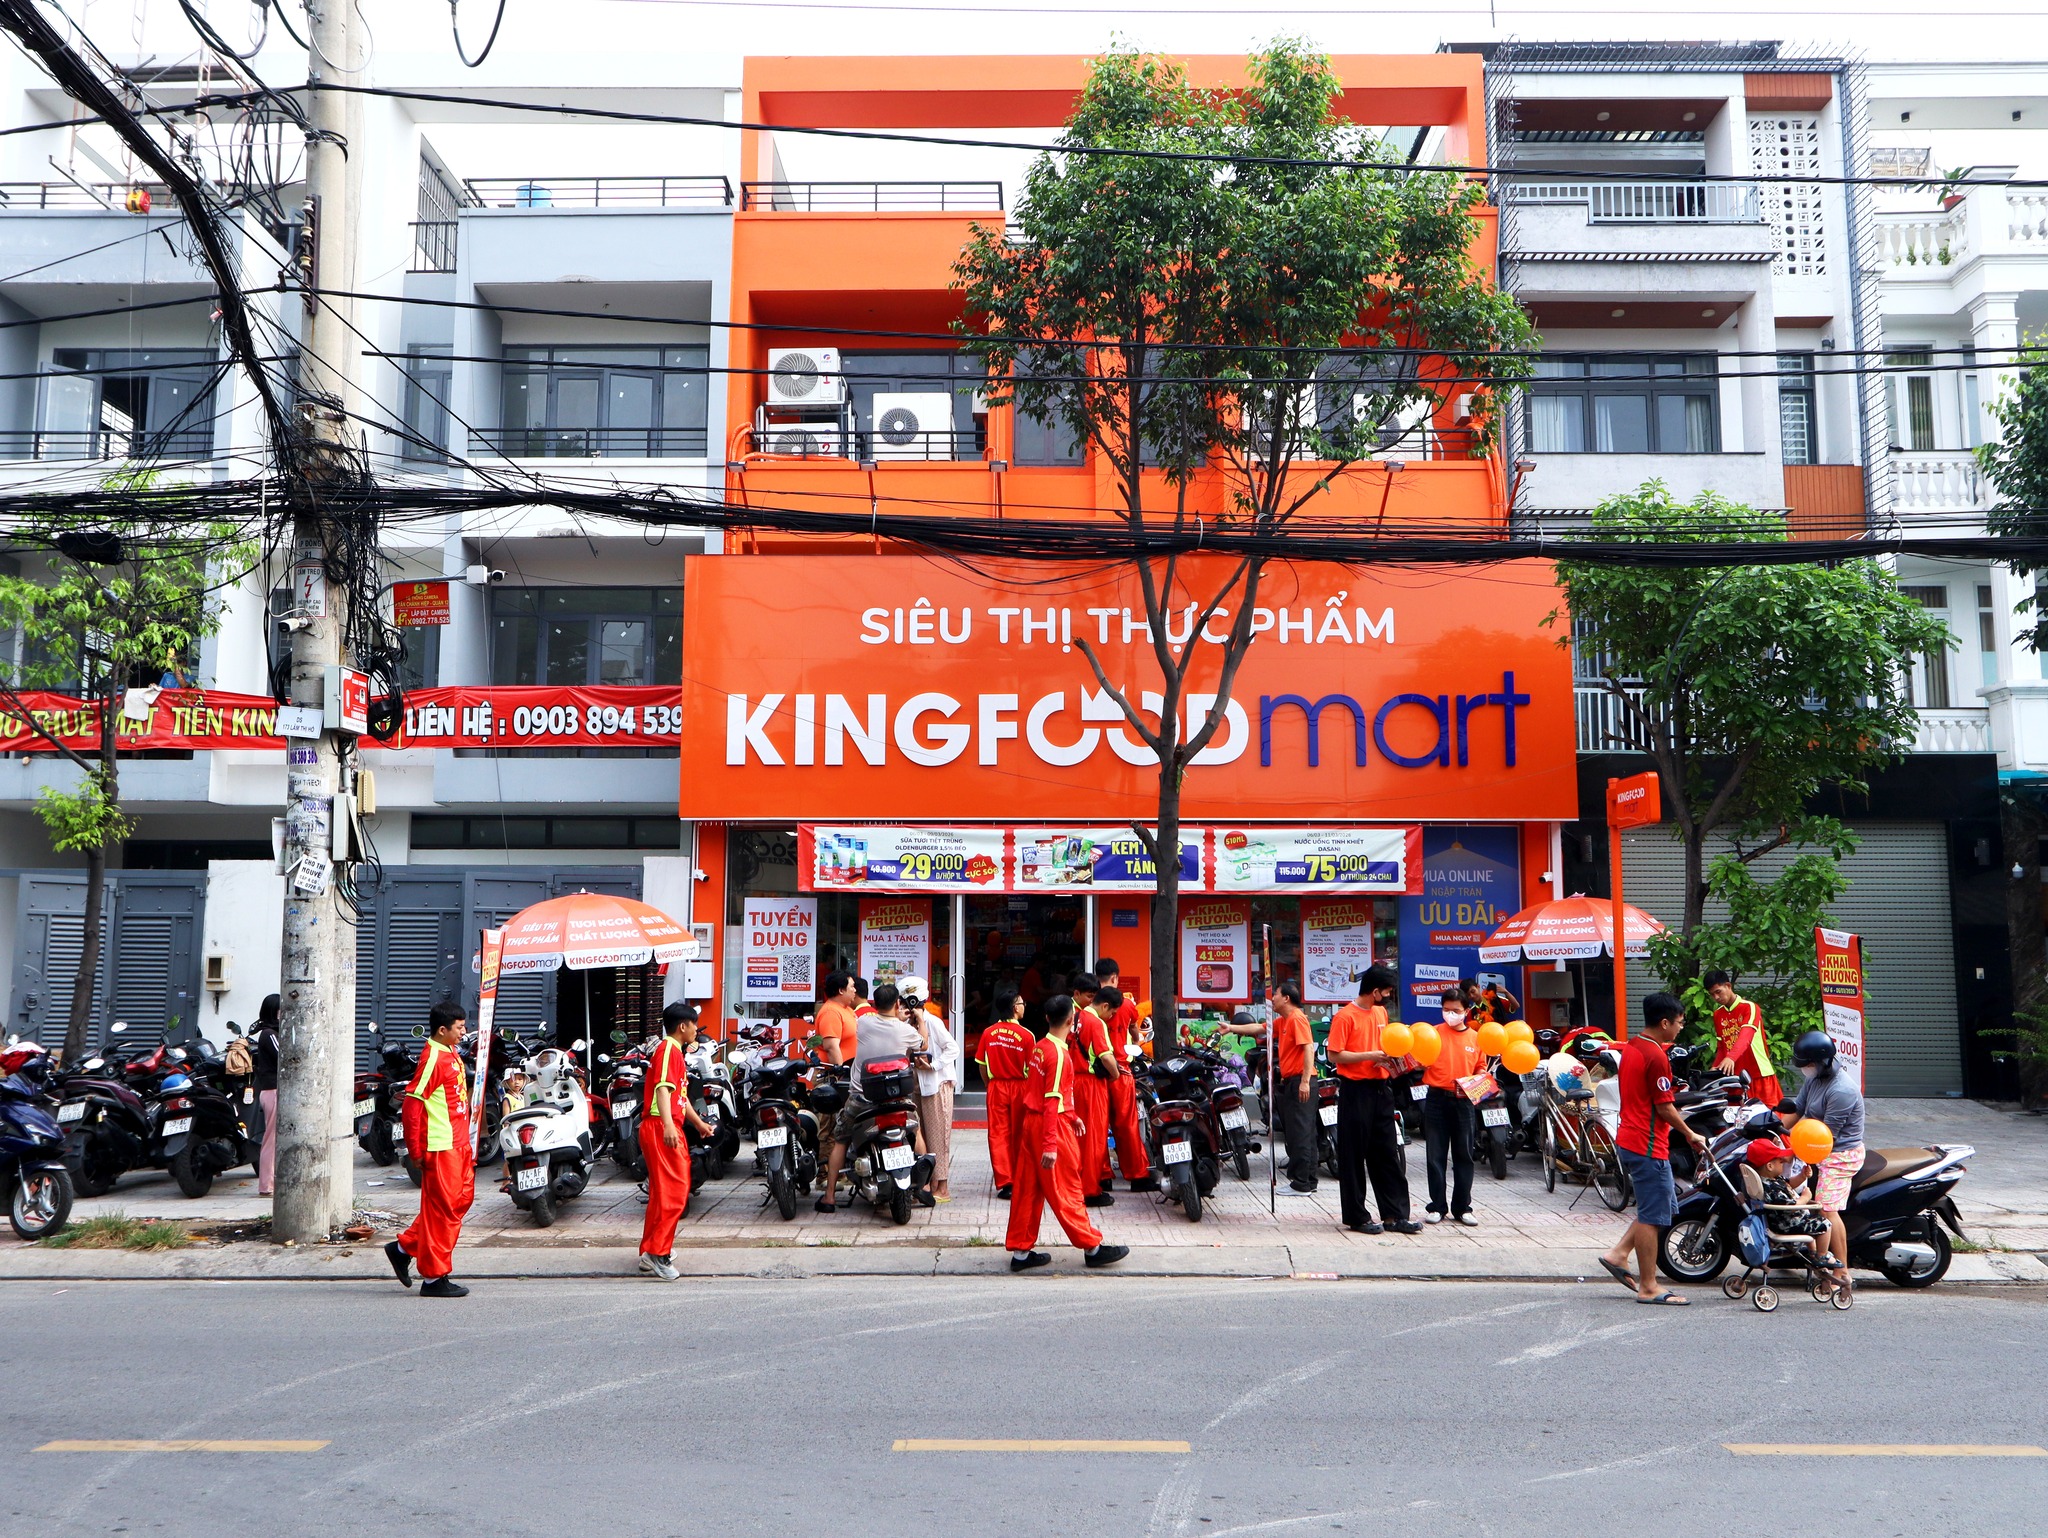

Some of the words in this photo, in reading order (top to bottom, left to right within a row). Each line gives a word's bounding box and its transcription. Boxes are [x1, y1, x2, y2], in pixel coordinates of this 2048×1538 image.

[860, 597, 972, 645] SIÊU
[988, 606, 1072, 654] THỊ
[1089, 606, 1231, 654] THỰC
[1250, 590, 1396, 645] PHẨM
[30, 703, 95, 739] THUÊ
[171, 694, 225, 738] TIỀN
[405, 701, 455, 738] LIÊN
[461, 700, 493, 744] HỆ
[512, 704, 580, 738] 0903
[584, 704, 638, 738] 894
[641, 704, 683, 737] 539
[1225, 835, 1246, 846] 510ML
[1346, 837, 1364, 845] KHIẾT
[1369, 873, 1377, 881] 24
[1377, 873, 1392, 881] CHAI
[1448, 869, 1494, 883] ONLINE
[748, 904, 813, 927] TUYỂN
[879, 905, 912, 917] KHAI
[1198, 904, 1230, 916] KHAI
[1320, 905, 1353, 917] KHAI
[1419, 900, 1451, 925] ƯU
[1455, 899, 1495, 925] ĐÃI
[598, 916, 634, 927] NGON
[867, 912, 923, 927] TRƯƠNG
[1185, 912, 1242, 927] TRƯƠNG
[1307, 913, 1365, 928] TRƯƠNG
[1537, 918, 1562, 927] TƯƠI
[1562, 915, 1594, 925] NGON
[569, 929, 599, 942] CHẤT
[599, 928, 641, 942] LƯỢNG
[1531, 926, 1558, 937] CHẤT
[1558, 925, 1596, 936] LƯỢNG
[752, 931, 808, 951] DỤNG
[863, 934, 886, 943] MUA
[896, 932, 920, 945] TẶNG
[921, 934, 927, 943] 1
[1199, 950, 1231, 961] 41.000
[1826, 955, 1848, 969] KHAI
[1419, 967, 1439, 978] NẮNG
[1439, 969, 1456, 979] MƯA
[1821, 969, 1858, 984] RƯƠNG
